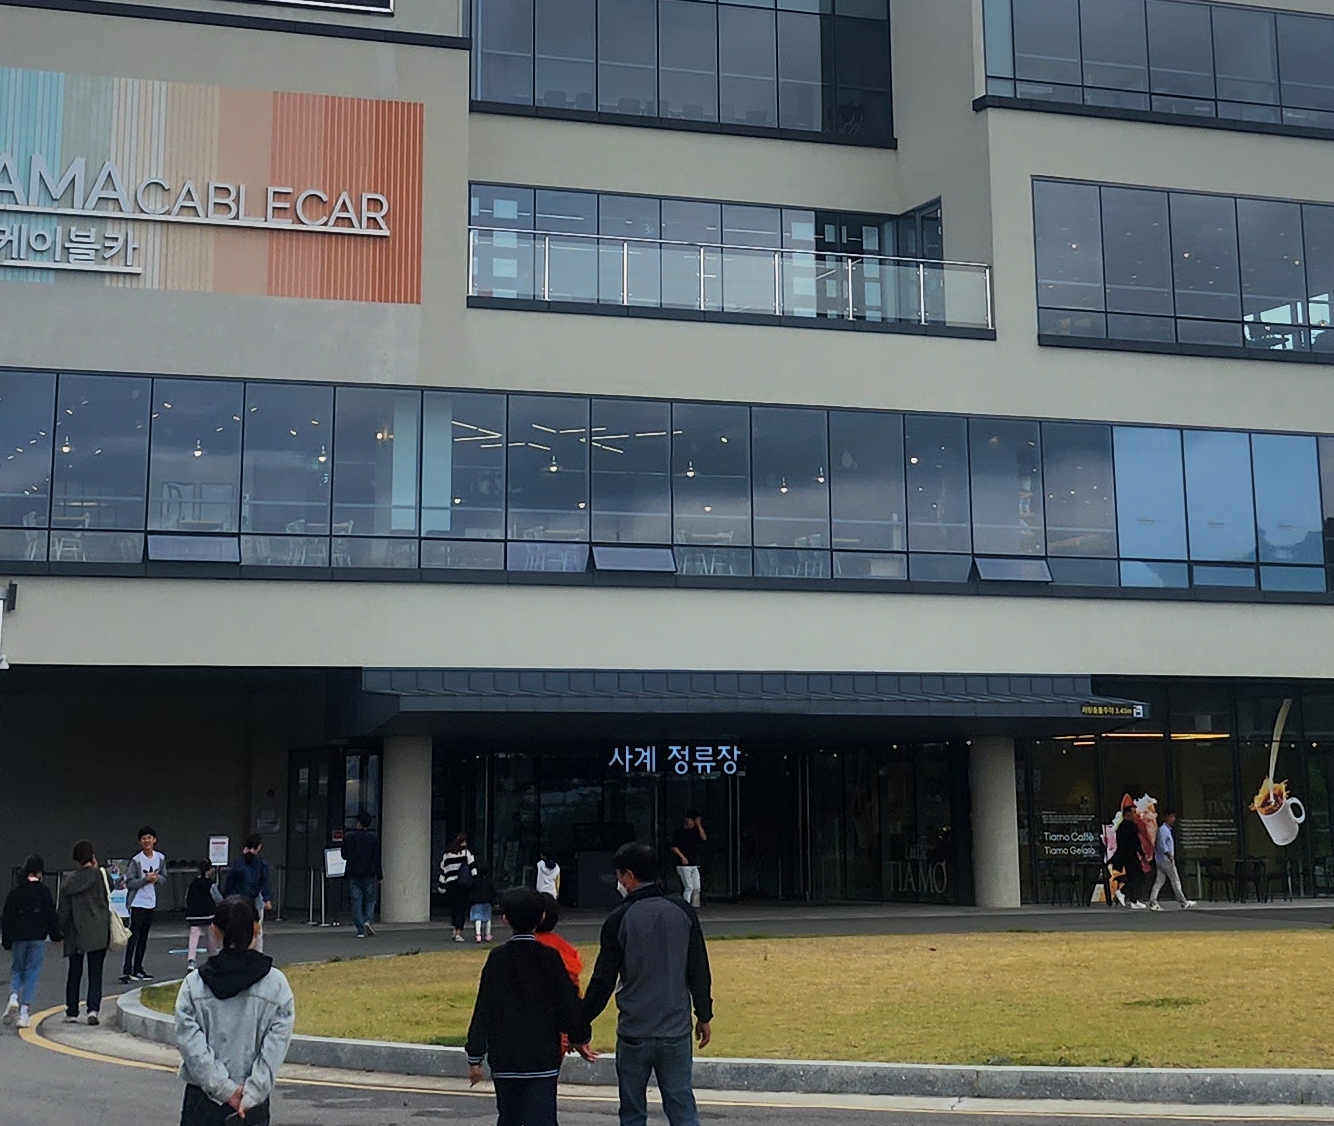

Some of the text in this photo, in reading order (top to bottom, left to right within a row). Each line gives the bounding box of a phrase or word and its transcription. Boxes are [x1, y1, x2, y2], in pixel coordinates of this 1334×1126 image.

[135, 176, 391, 231] CABLECAR
[608, 745, 742, 775] 사계 정류장
[1043, 831, 1070, 842] Tiamo
[1043, 845, 1069, 855] Tiamo
[885, 860, 947, 893] TIAMO
